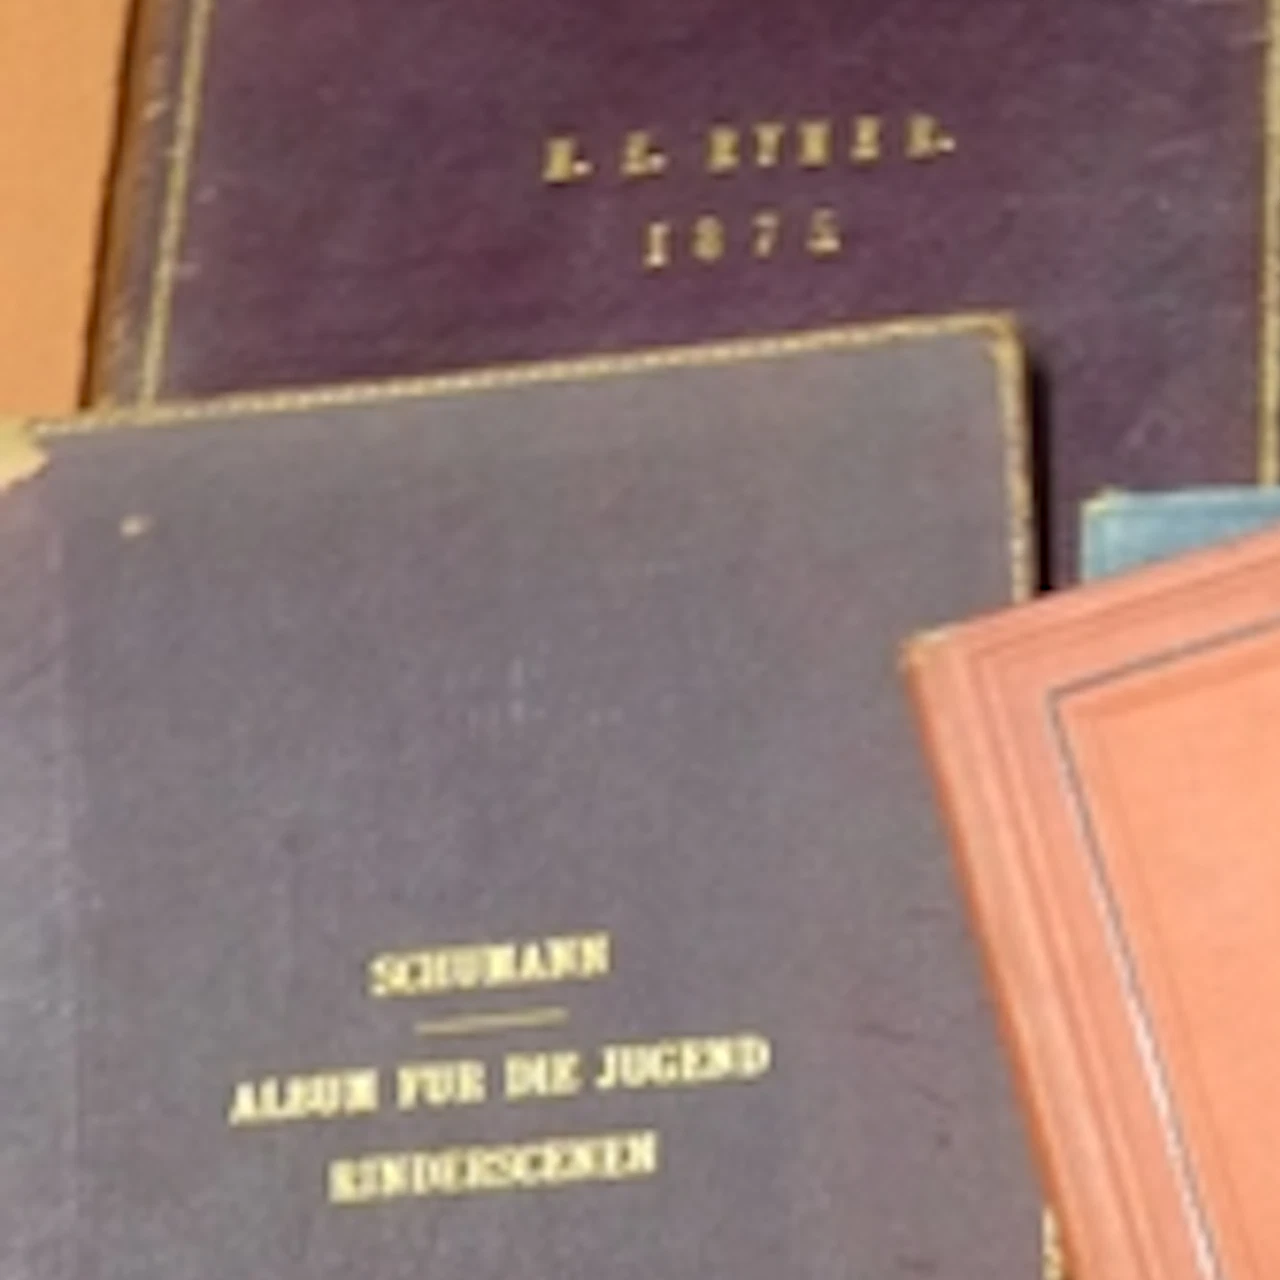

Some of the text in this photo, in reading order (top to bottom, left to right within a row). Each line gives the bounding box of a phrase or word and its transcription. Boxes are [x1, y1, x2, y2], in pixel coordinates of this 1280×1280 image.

[366, 931, 614, 999] SCHUMANN
[228, 1066, 382, 1128] ALBUM
[503, 1049, 583, 1099] DIE
[594, 1032, 774, 1090] JUGEND
